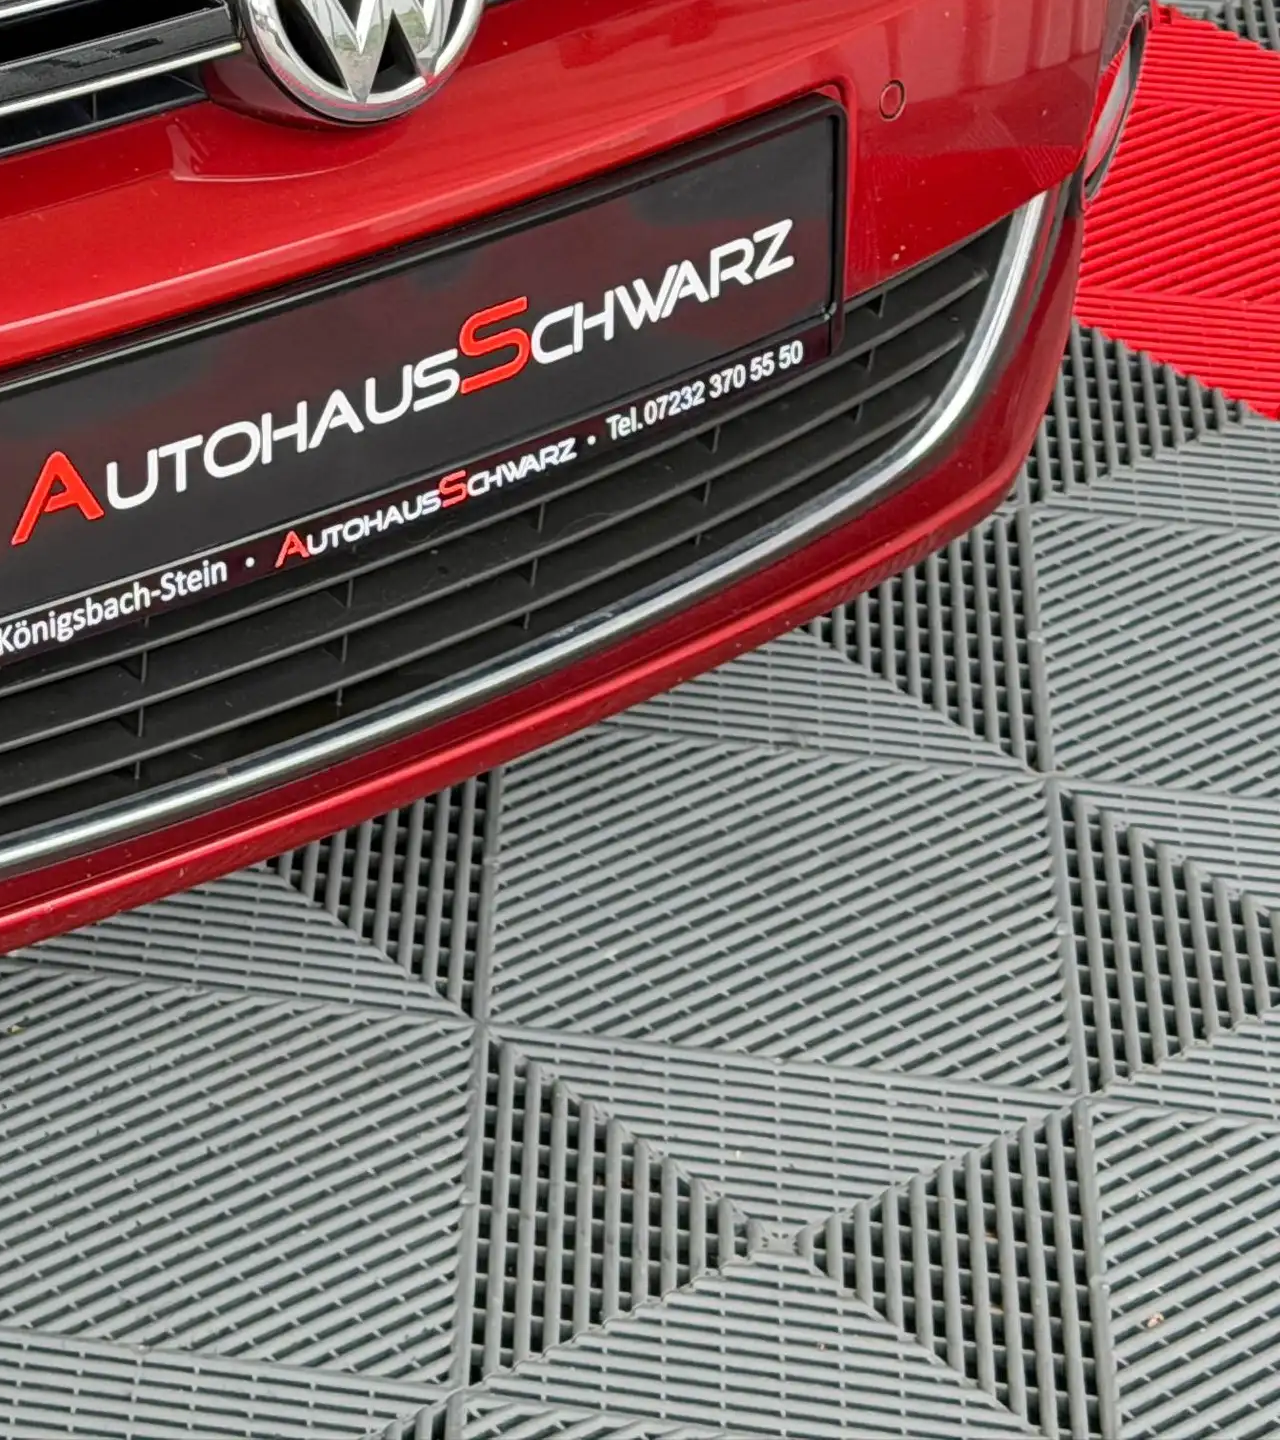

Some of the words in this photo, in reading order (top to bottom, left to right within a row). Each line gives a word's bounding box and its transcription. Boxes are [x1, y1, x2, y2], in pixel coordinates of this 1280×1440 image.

[709, 364, 746, 399] 370
[750, 351, 775, 382] 55
[779, 340, 804, 370] 50
